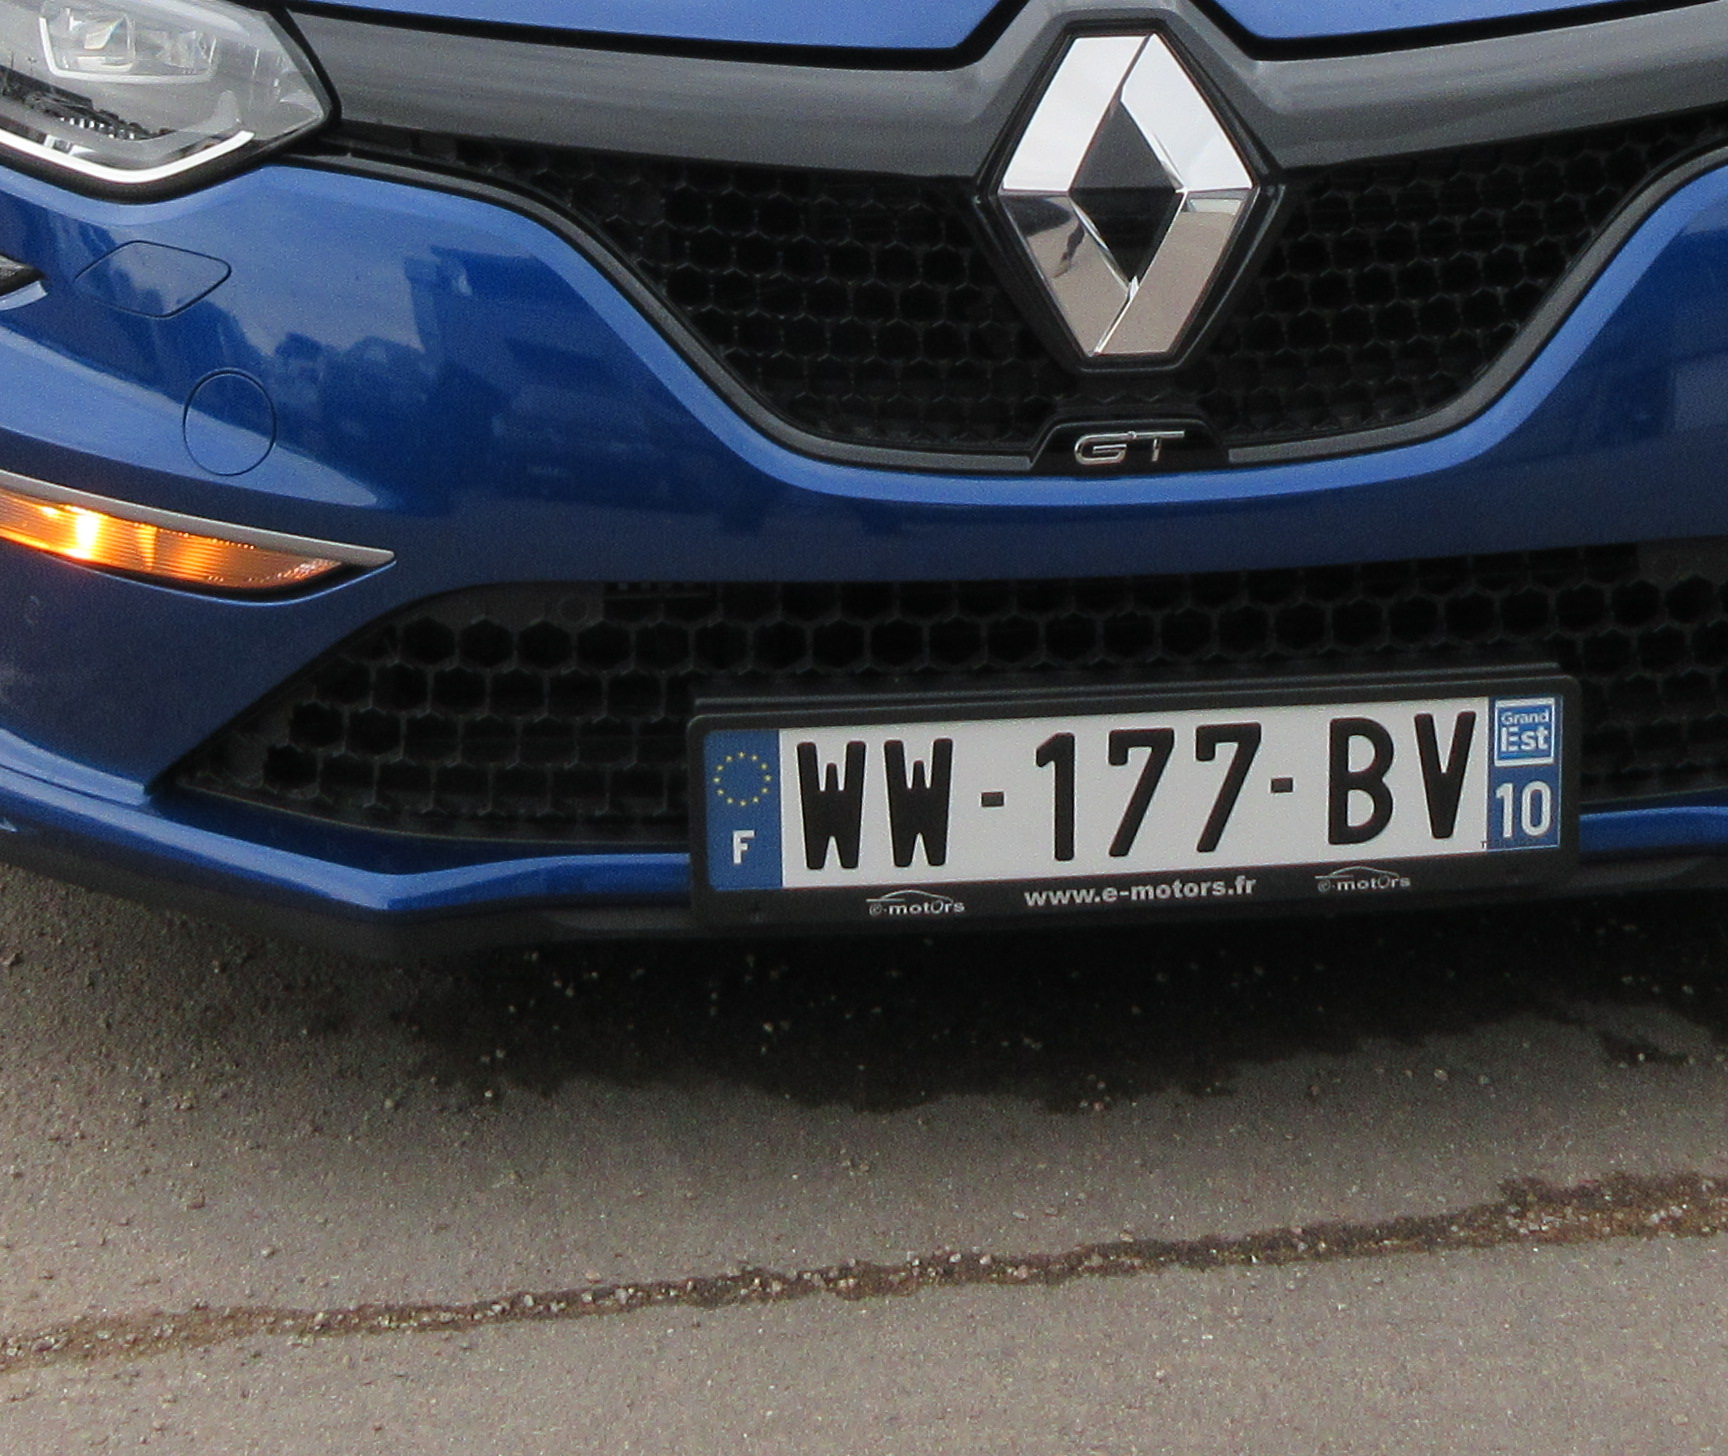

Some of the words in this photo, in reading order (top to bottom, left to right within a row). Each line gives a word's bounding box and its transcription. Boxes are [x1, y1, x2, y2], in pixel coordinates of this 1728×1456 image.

[1074, 430, 1185, 465] GT
[1501, 711, 1550, 725] Grand
[1501, 726, 1549, 752] Est
[1495, 780, 1552, 839] 10
[732, 829, 757, 865] F
[1024, 875, 1258, 907] www.e-motors.fr
